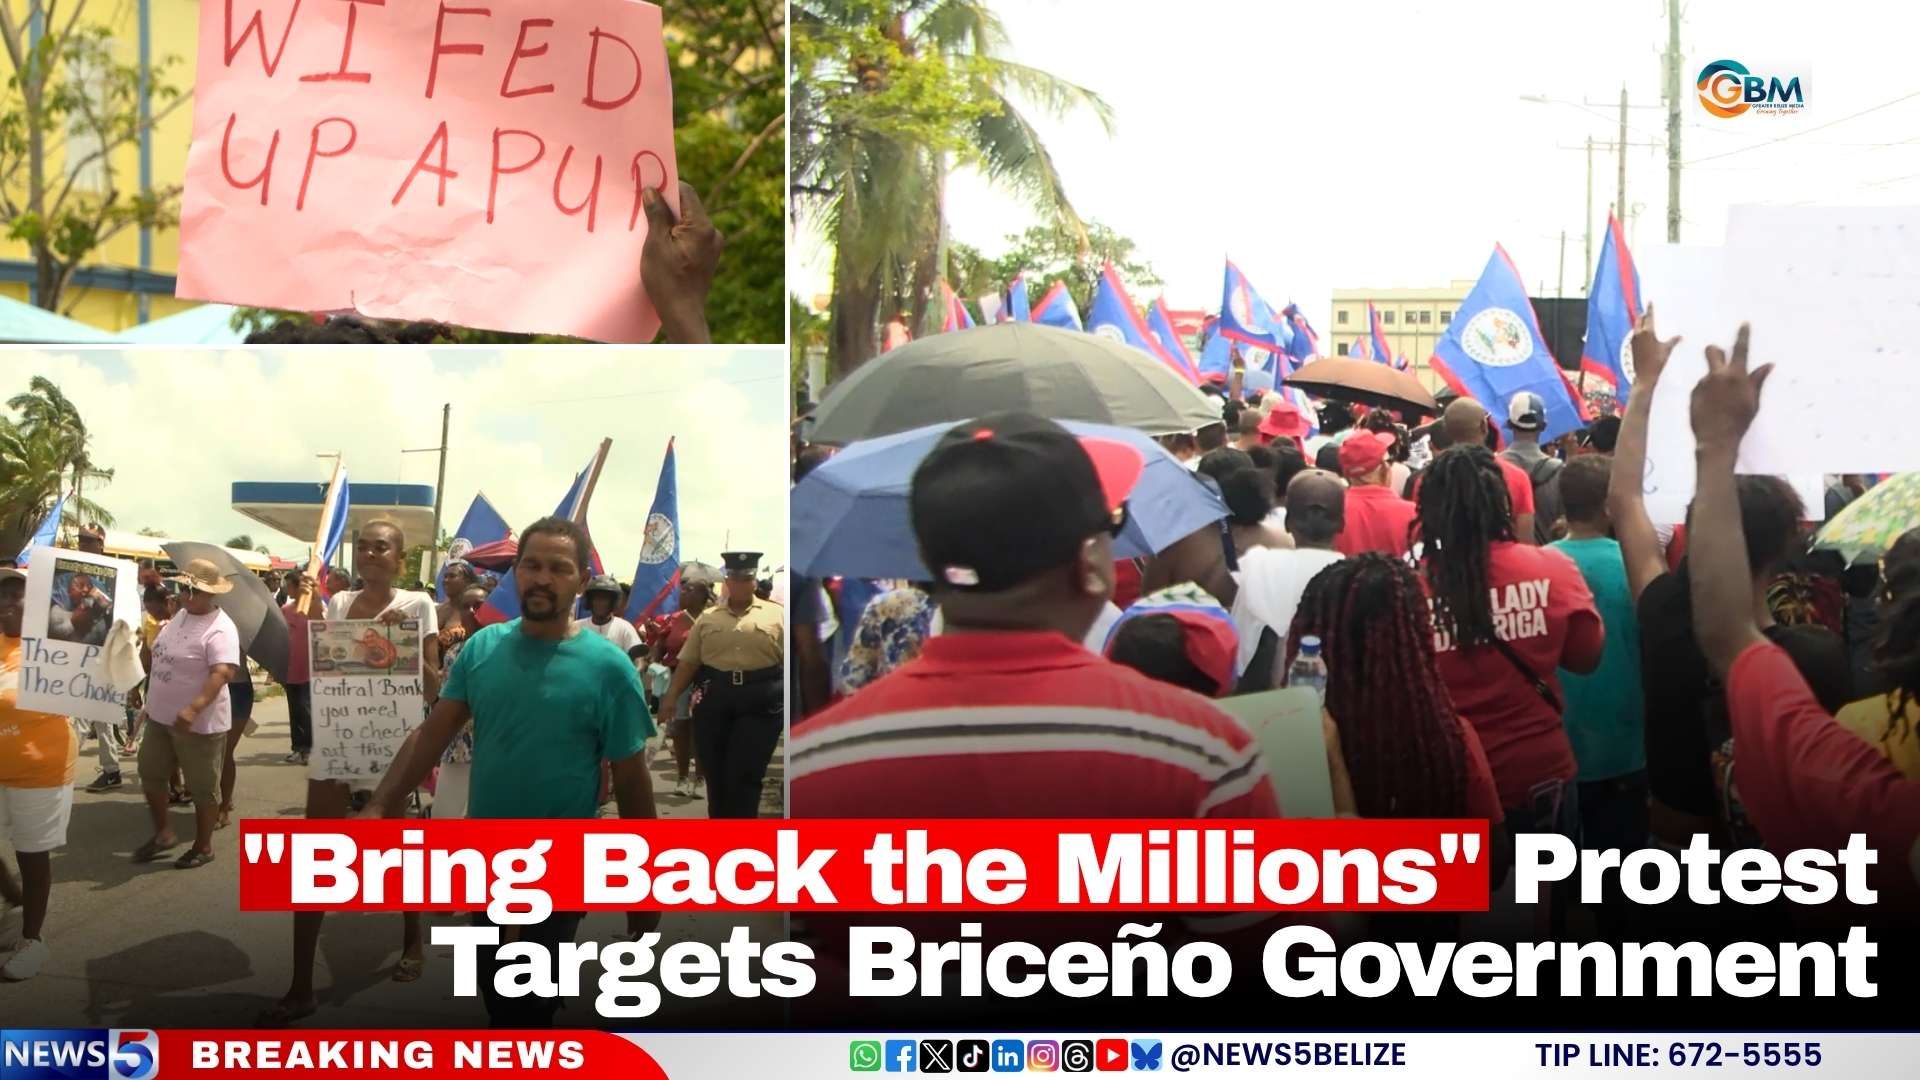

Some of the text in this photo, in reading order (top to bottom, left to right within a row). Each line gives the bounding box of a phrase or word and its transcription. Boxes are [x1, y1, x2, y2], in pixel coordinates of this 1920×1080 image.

[426, 0, 643, 110] FED
[221, 113, 358, 211] UP
[1490, 578, 1550, 615] LADY
[22, 637, 69, 666] The
[23, 667, 65, 696] The
[312, 678, 424, 697] Central Bank
[320, 701, 398, 728] you need
[331, 721, 354, 739] to
